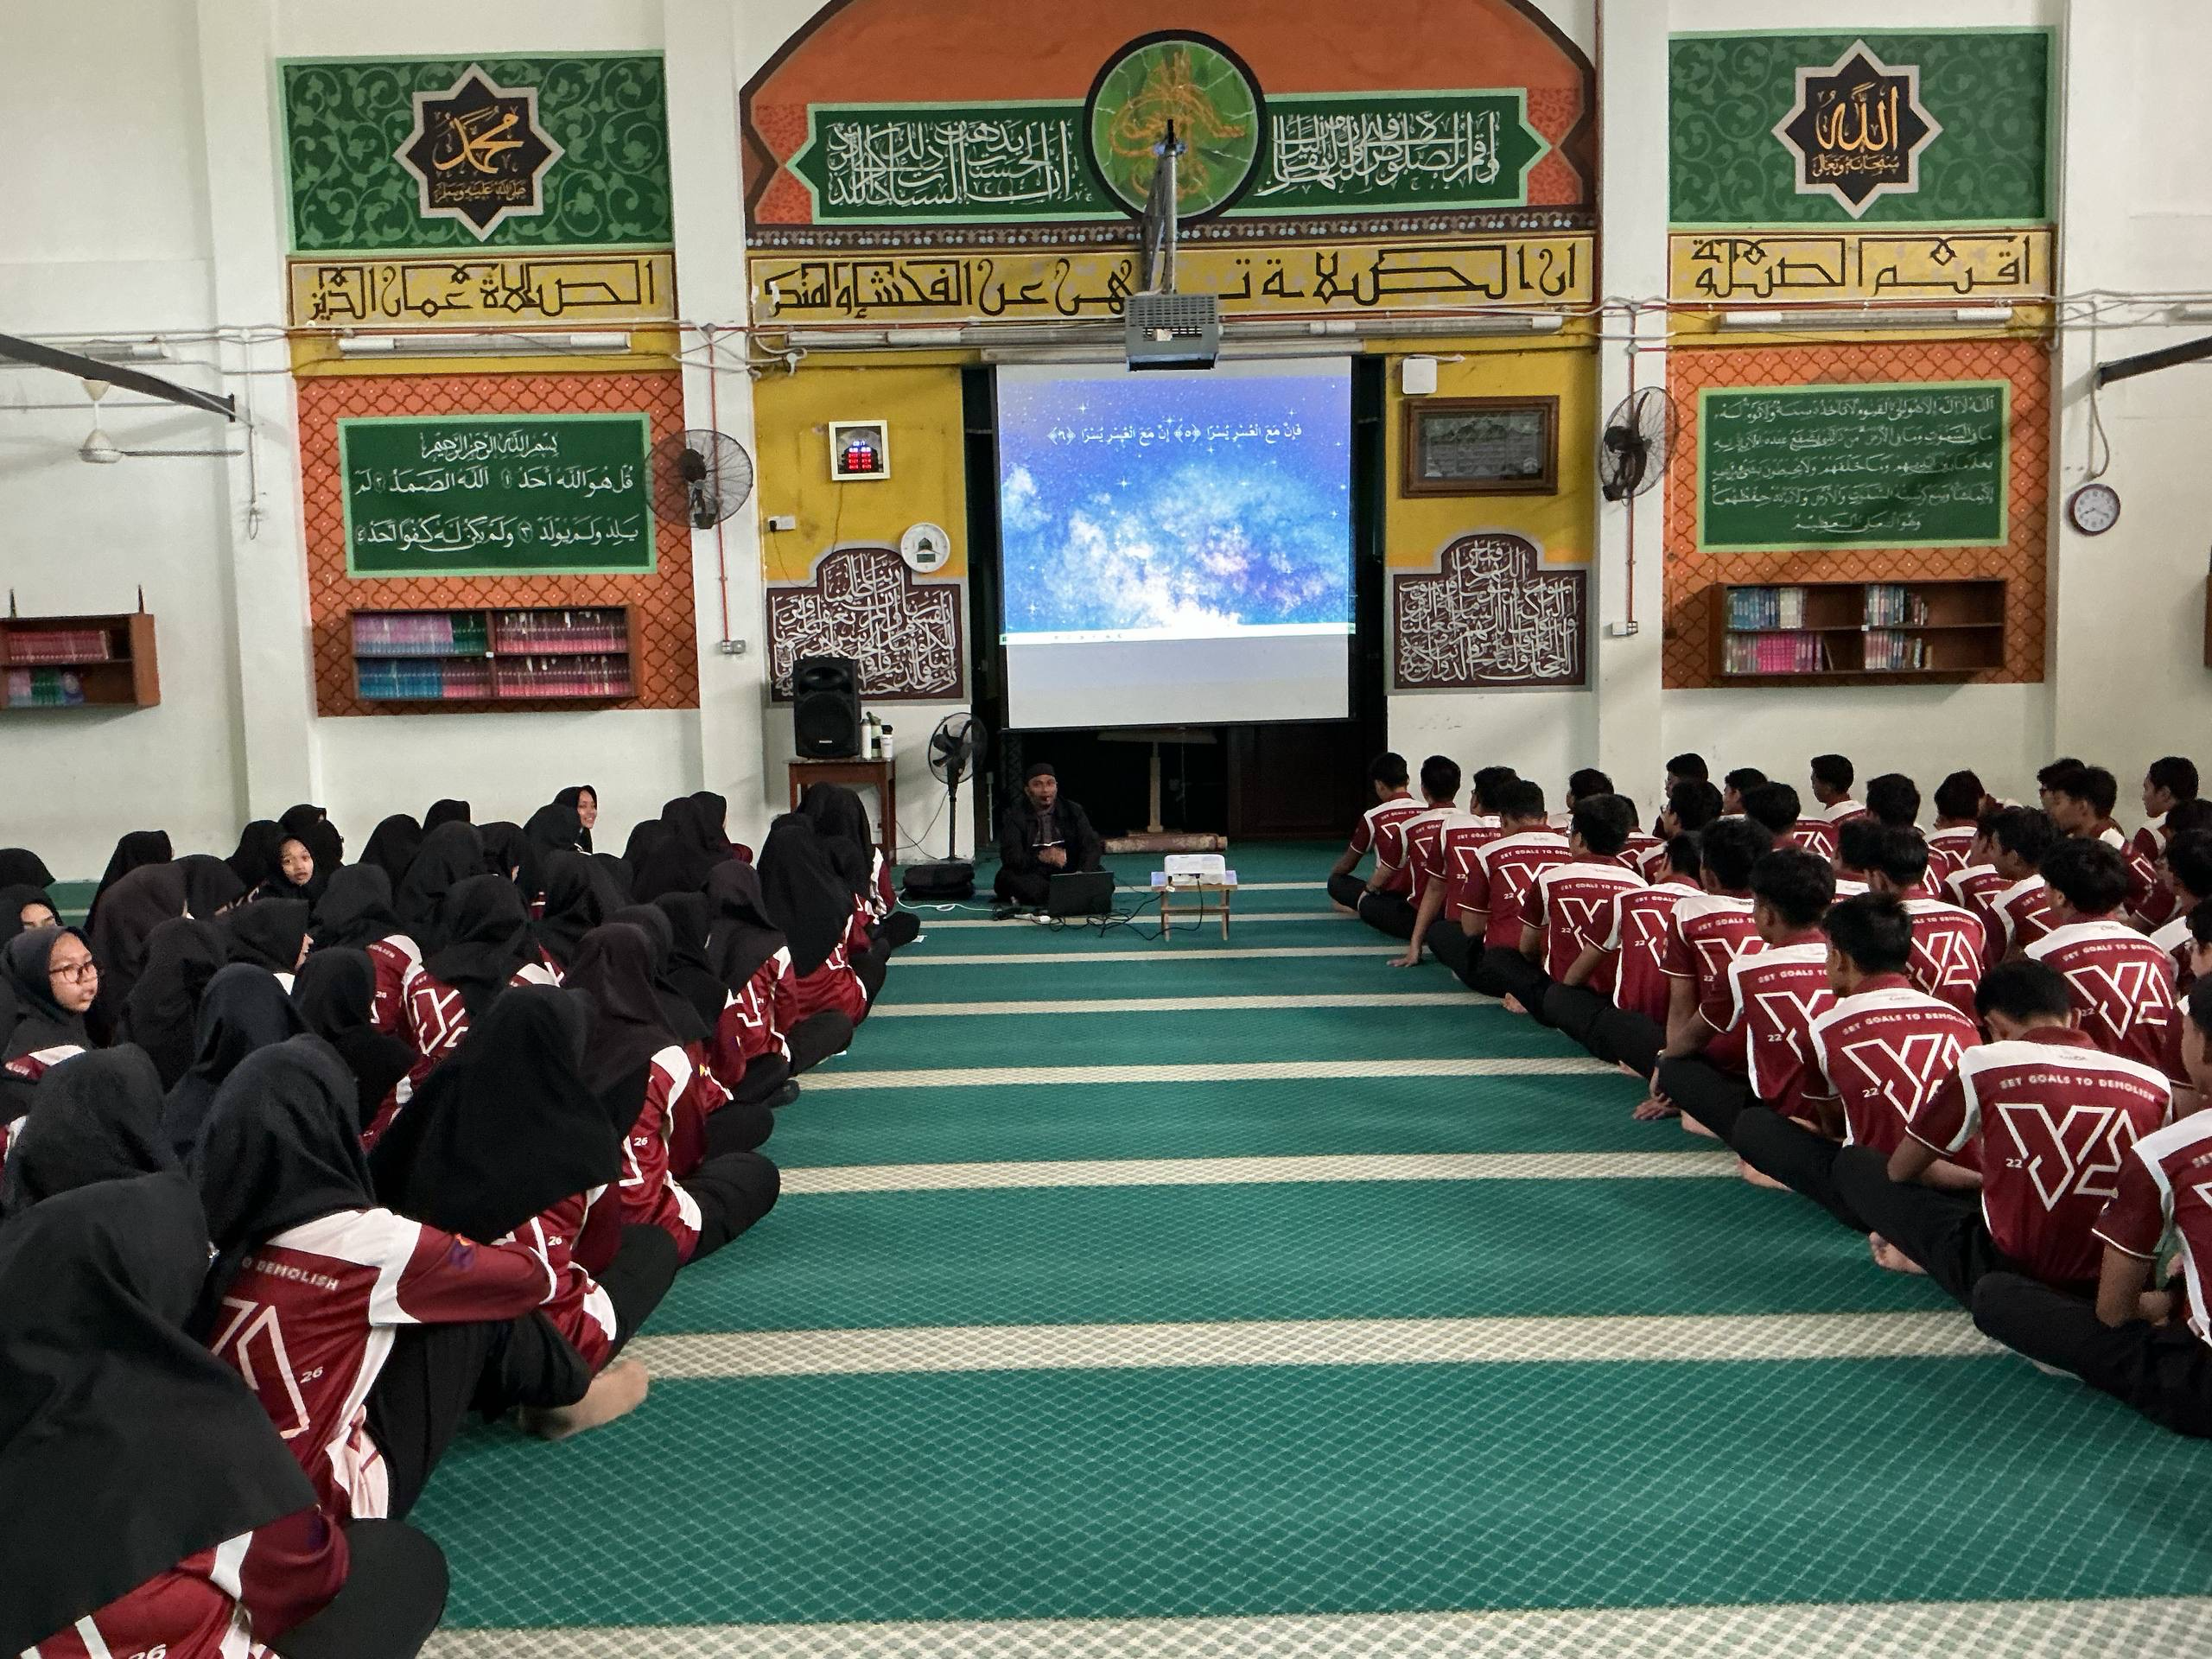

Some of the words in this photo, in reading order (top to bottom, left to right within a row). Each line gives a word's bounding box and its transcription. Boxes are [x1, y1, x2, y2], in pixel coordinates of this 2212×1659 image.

[1815, 83, 1898, 152] الله
[1780, 969, 1814, 978] GOALS
[1865, 1013, 1902, 1026] GOALS
[1906, 1013, 1922, 1021] TO
[1767, 1033, 1783, 1043] 22
[1862, 1087, 1879, 1099] 22
[1999, 1079, 2023, 1090] SET
[2028, 1073, 2071, 1085] GOALS
[2075, 1077, 2094, 1087] TO
[2099, 1078, 2156, 1103] DEMOLISH
[633, 1136, 648, 1147] 26
[2005, 1158, 2023, 1169] 22
[547, 1235, 563, 1247] 26
[256, 1260, 340, 1292] DEMOLISH
[300, 1365, 324, 1384] 26
